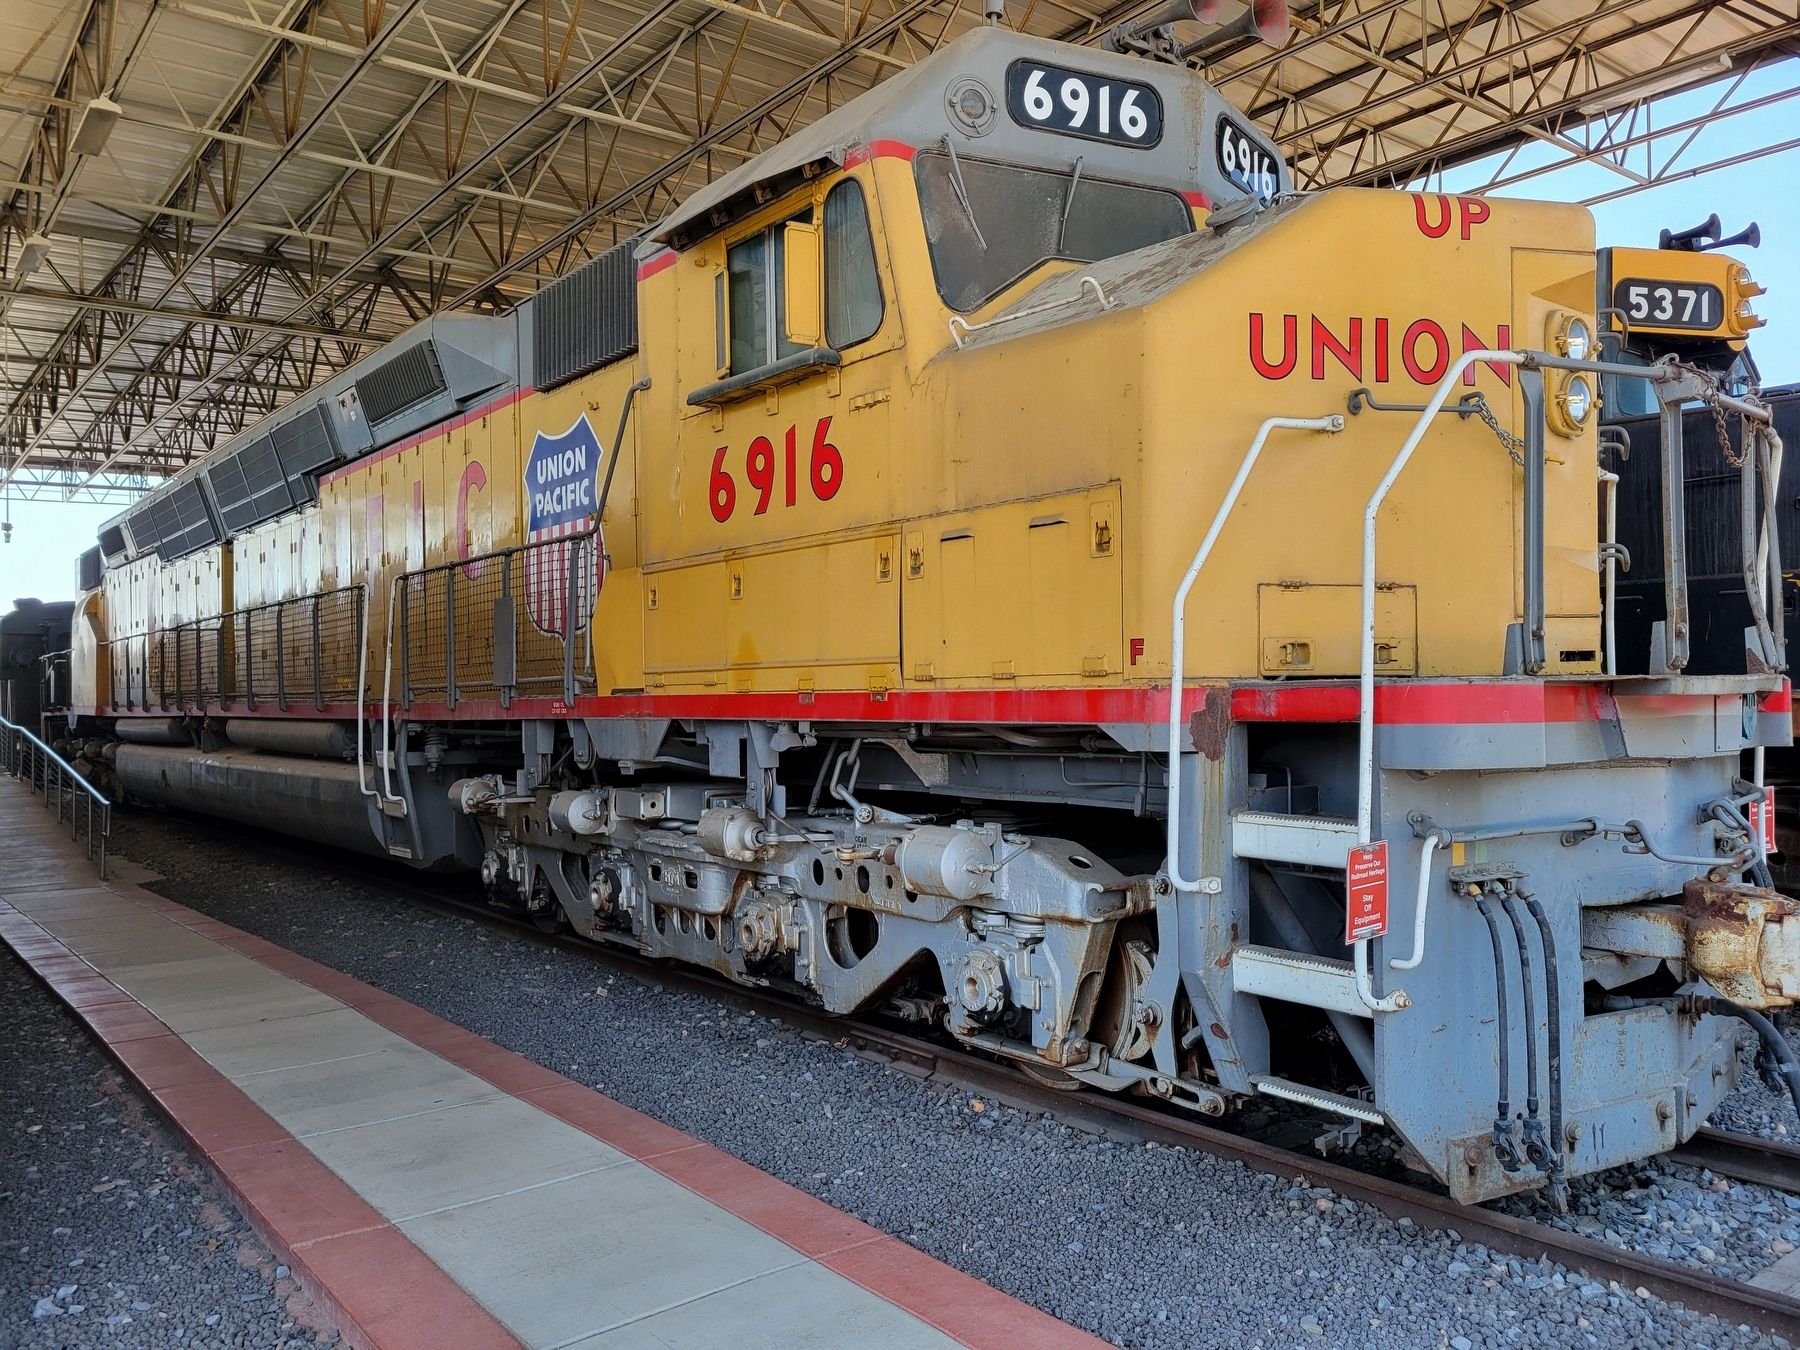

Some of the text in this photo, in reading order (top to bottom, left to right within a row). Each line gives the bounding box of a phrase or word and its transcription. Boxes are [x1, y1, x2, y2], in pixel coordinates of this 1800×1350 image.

[1023, 69, 1147, 138] 6916
[1222, 125, 1273, 200] 6916
[1411, 193, 1491, 240] UP
[1628, 286, 1710, 323] 5371
[1249, 312, 1511, 388] UNION
[537, 444, 586, 485] UNION
[708, 415, 844, 523] 6916
[535, 478, 590, 518] PACIFIC
[1130, 638, 1145, 666] F
[1355, 863, 1373, 871] Preserve
[1354, 912, 1381, 925] Equipment
[1362, 894, 1374, 903] Stay
[1364, 904, 1372, 912] Off
